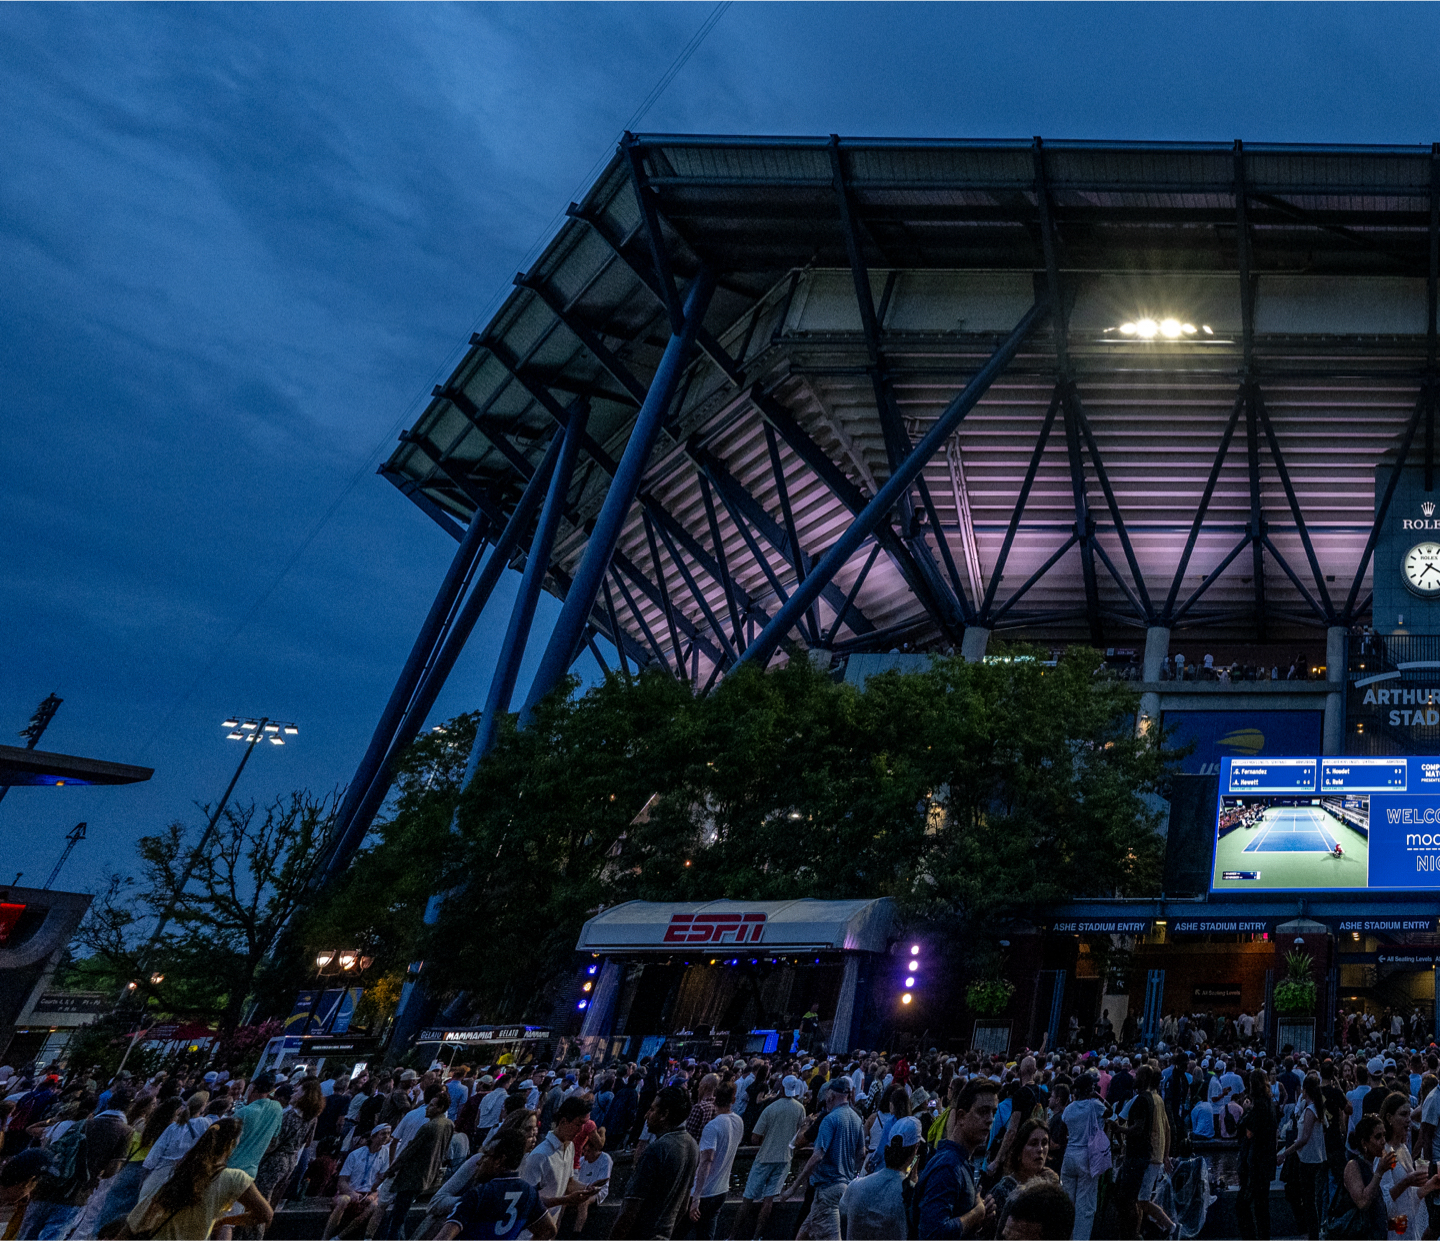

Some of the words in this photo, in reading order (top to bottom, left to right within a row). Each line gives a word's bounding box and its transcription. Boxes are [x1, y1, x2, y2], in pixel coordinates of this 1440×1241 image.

[663, 913, 768, 943] ESPN
[1053, 922, 1077, 931] ASHE
[1077, 922, 1116, 931] STADIUM
[1117, 922, 1146, 931] ENTRY
[1174, 922, 1198, 931] ASHE
[1199, 922, 1237, 931] STADIUM
[1238, 922, 1267, 930] ENTRY
[1339, 921, 1362, 930] ASHE
[1364, 921, 1401, 930] STADIUM
[1402, 921, 1430, 929] ENTRY
[1394, 955, 1414, 964] Seating
[1415, 955, 1432, 963] Levels
[445, 1031, 494, 1041] MAMMAMIA
[498, 1029, 519, 1037] GELATO
[494, 1191, 523, 1236] 3
